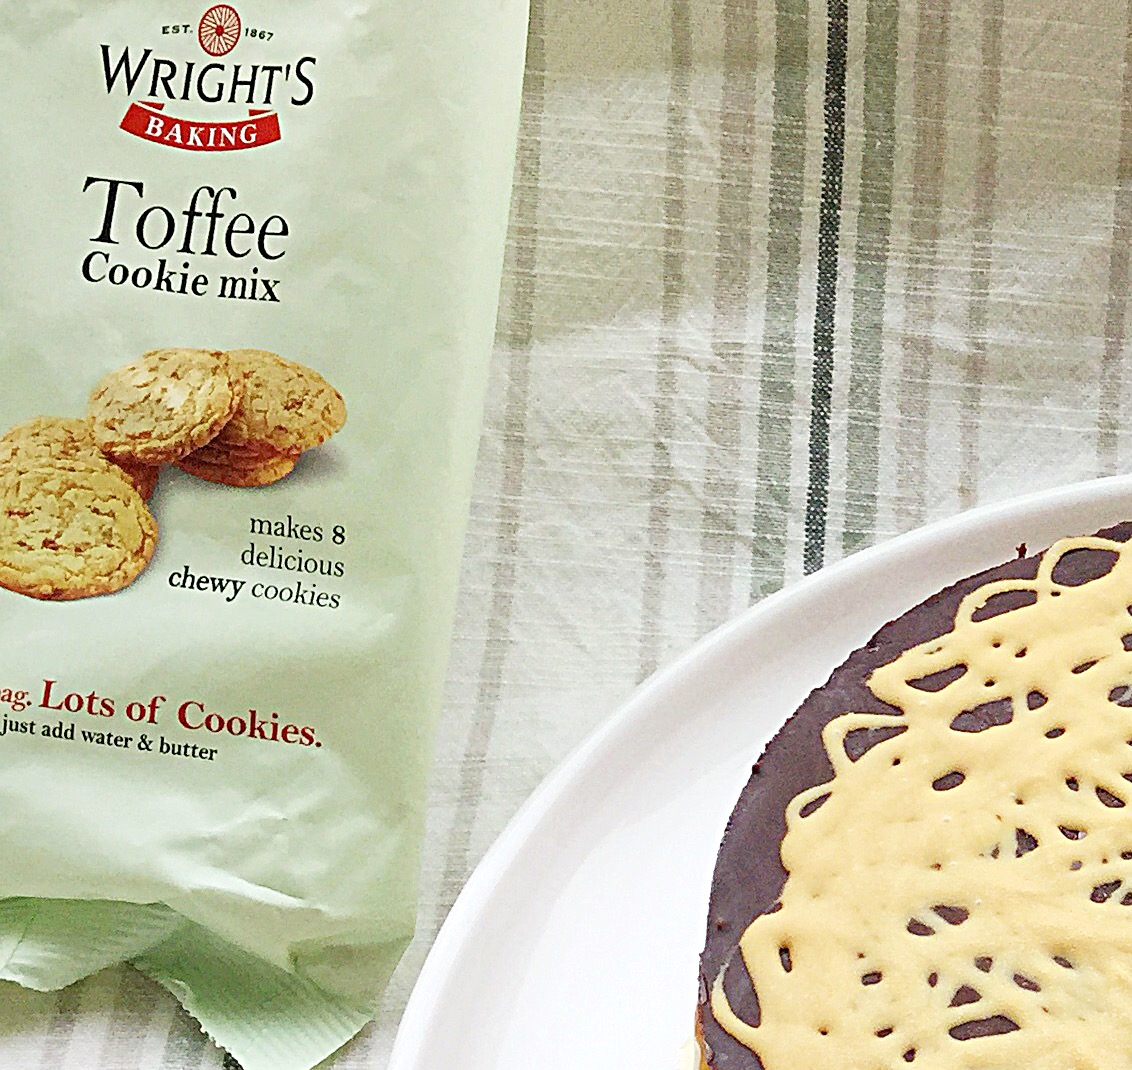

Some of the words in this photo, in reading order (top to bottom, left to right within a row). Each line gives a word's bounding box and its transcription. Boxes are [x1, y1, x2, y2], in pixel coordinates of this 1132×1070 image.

[162, 24, 193, 35] EST.
[244, 27, 274, 42] 1867
[99, 43, 317, 106] WRIGHT'S
[144, 115, 258, 148] BAKING
[81, 176, 290, 261] Toffee
[81, 251, 209, 298] Cookie
[218, 267, 282, 303] mix
[249, 514, 324, 542] makes
[332, 524, 347, 545] 8
[240, 543, 346, 577] delicious
[168, 566, 246, 602] chewy
[251, 582, 341, 609] cookies
[0, 687, 32, 712] ag.
[38, 679, 116, 718] Lots
[125, 695, 167, 725] of
[177, 700, 324, 749] Cookies.
[0, 714, 36, 736] just
[41, 721, 76, 741] add
[81, 729, 133, 749] water
[137, 733, 153, 752] &
[159, 736, 218, 761] butter
